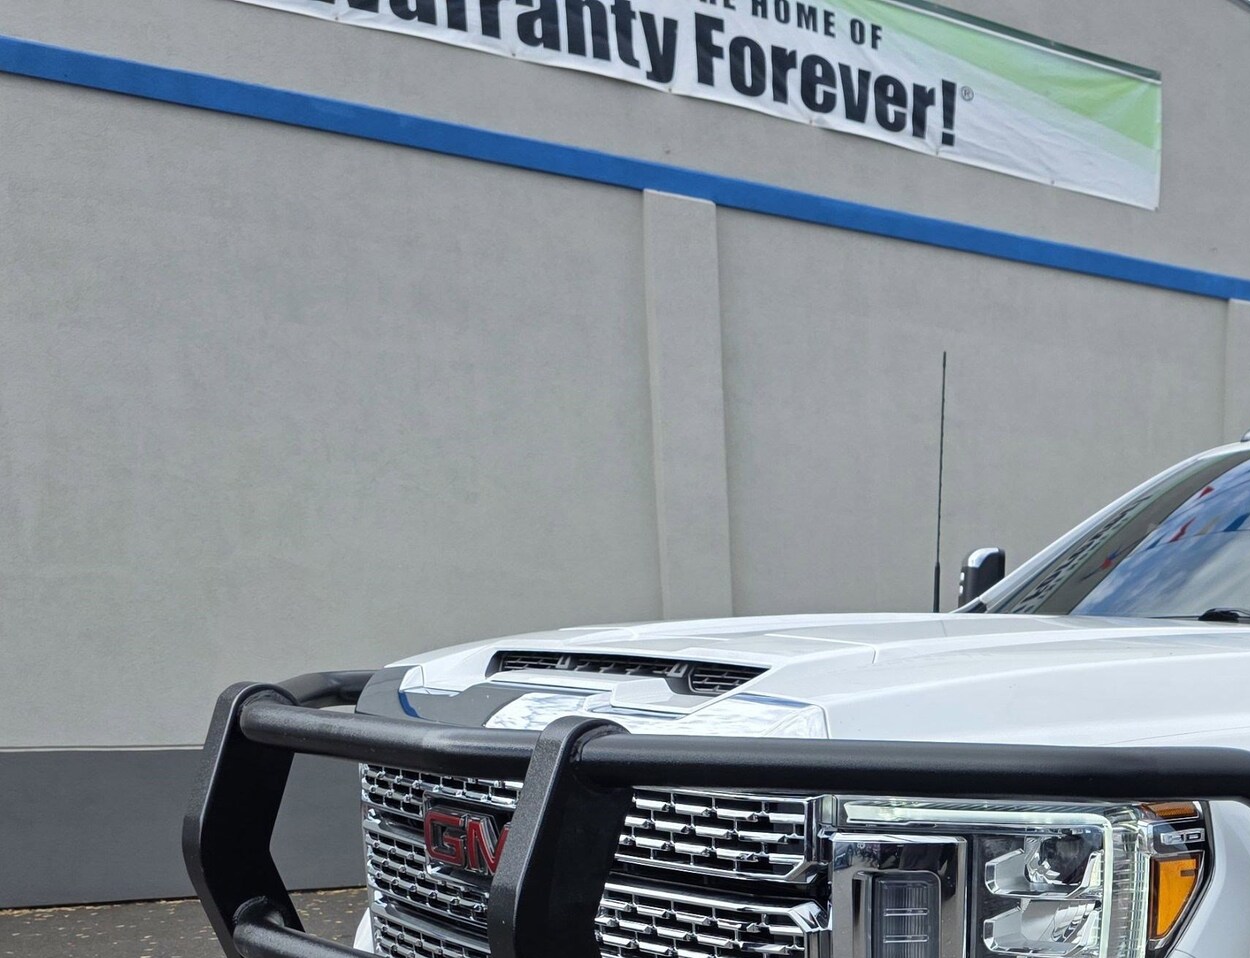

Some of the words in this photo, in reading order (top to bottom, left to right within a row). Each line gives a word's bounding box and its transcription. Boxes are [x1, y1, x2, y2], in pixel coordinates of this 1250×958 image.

[300, 0, 678, 84] rranty
[751, 0, 836, 38] HOME
[850, 18, 882, 50] OF
[424, 808, 512, 877] GM
